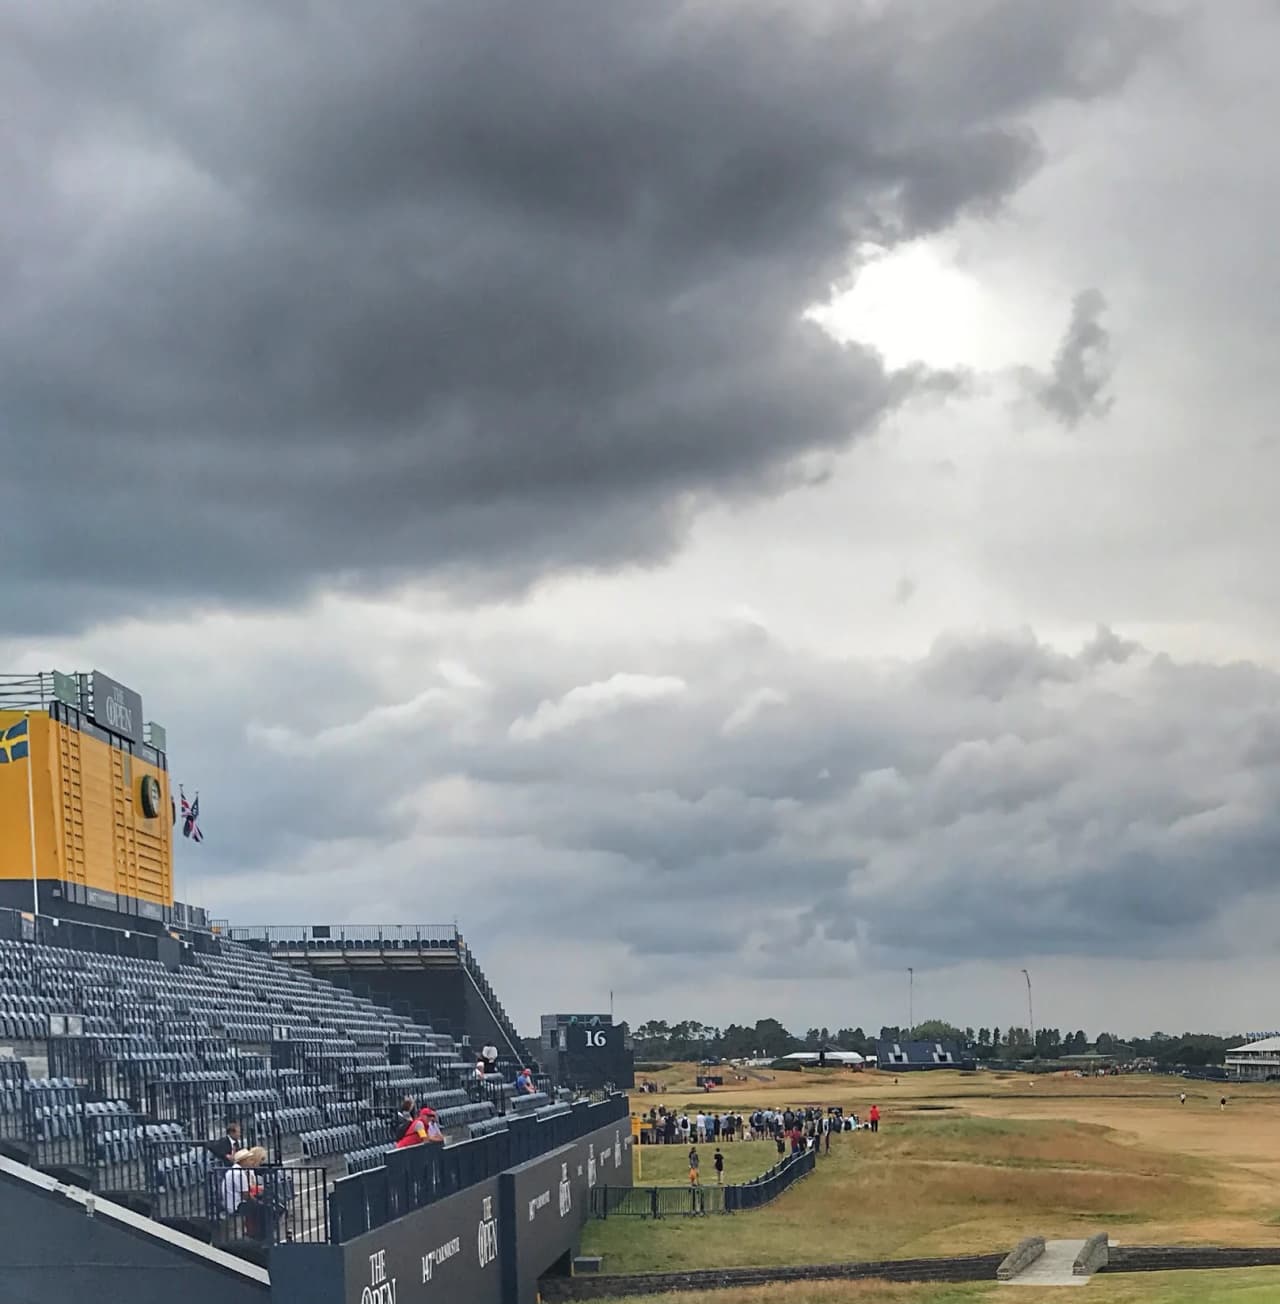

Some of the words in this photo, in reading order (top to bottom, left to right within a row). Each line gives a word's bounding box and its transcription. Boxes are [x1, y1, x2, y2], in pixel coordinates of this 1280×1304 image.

[106, 696, 132, 733] OPEN
[584, 1030, 606, 1047] 16
[478, 1218, 498, 1268] OPEN
[369, 1250, 386, 1286] THE
